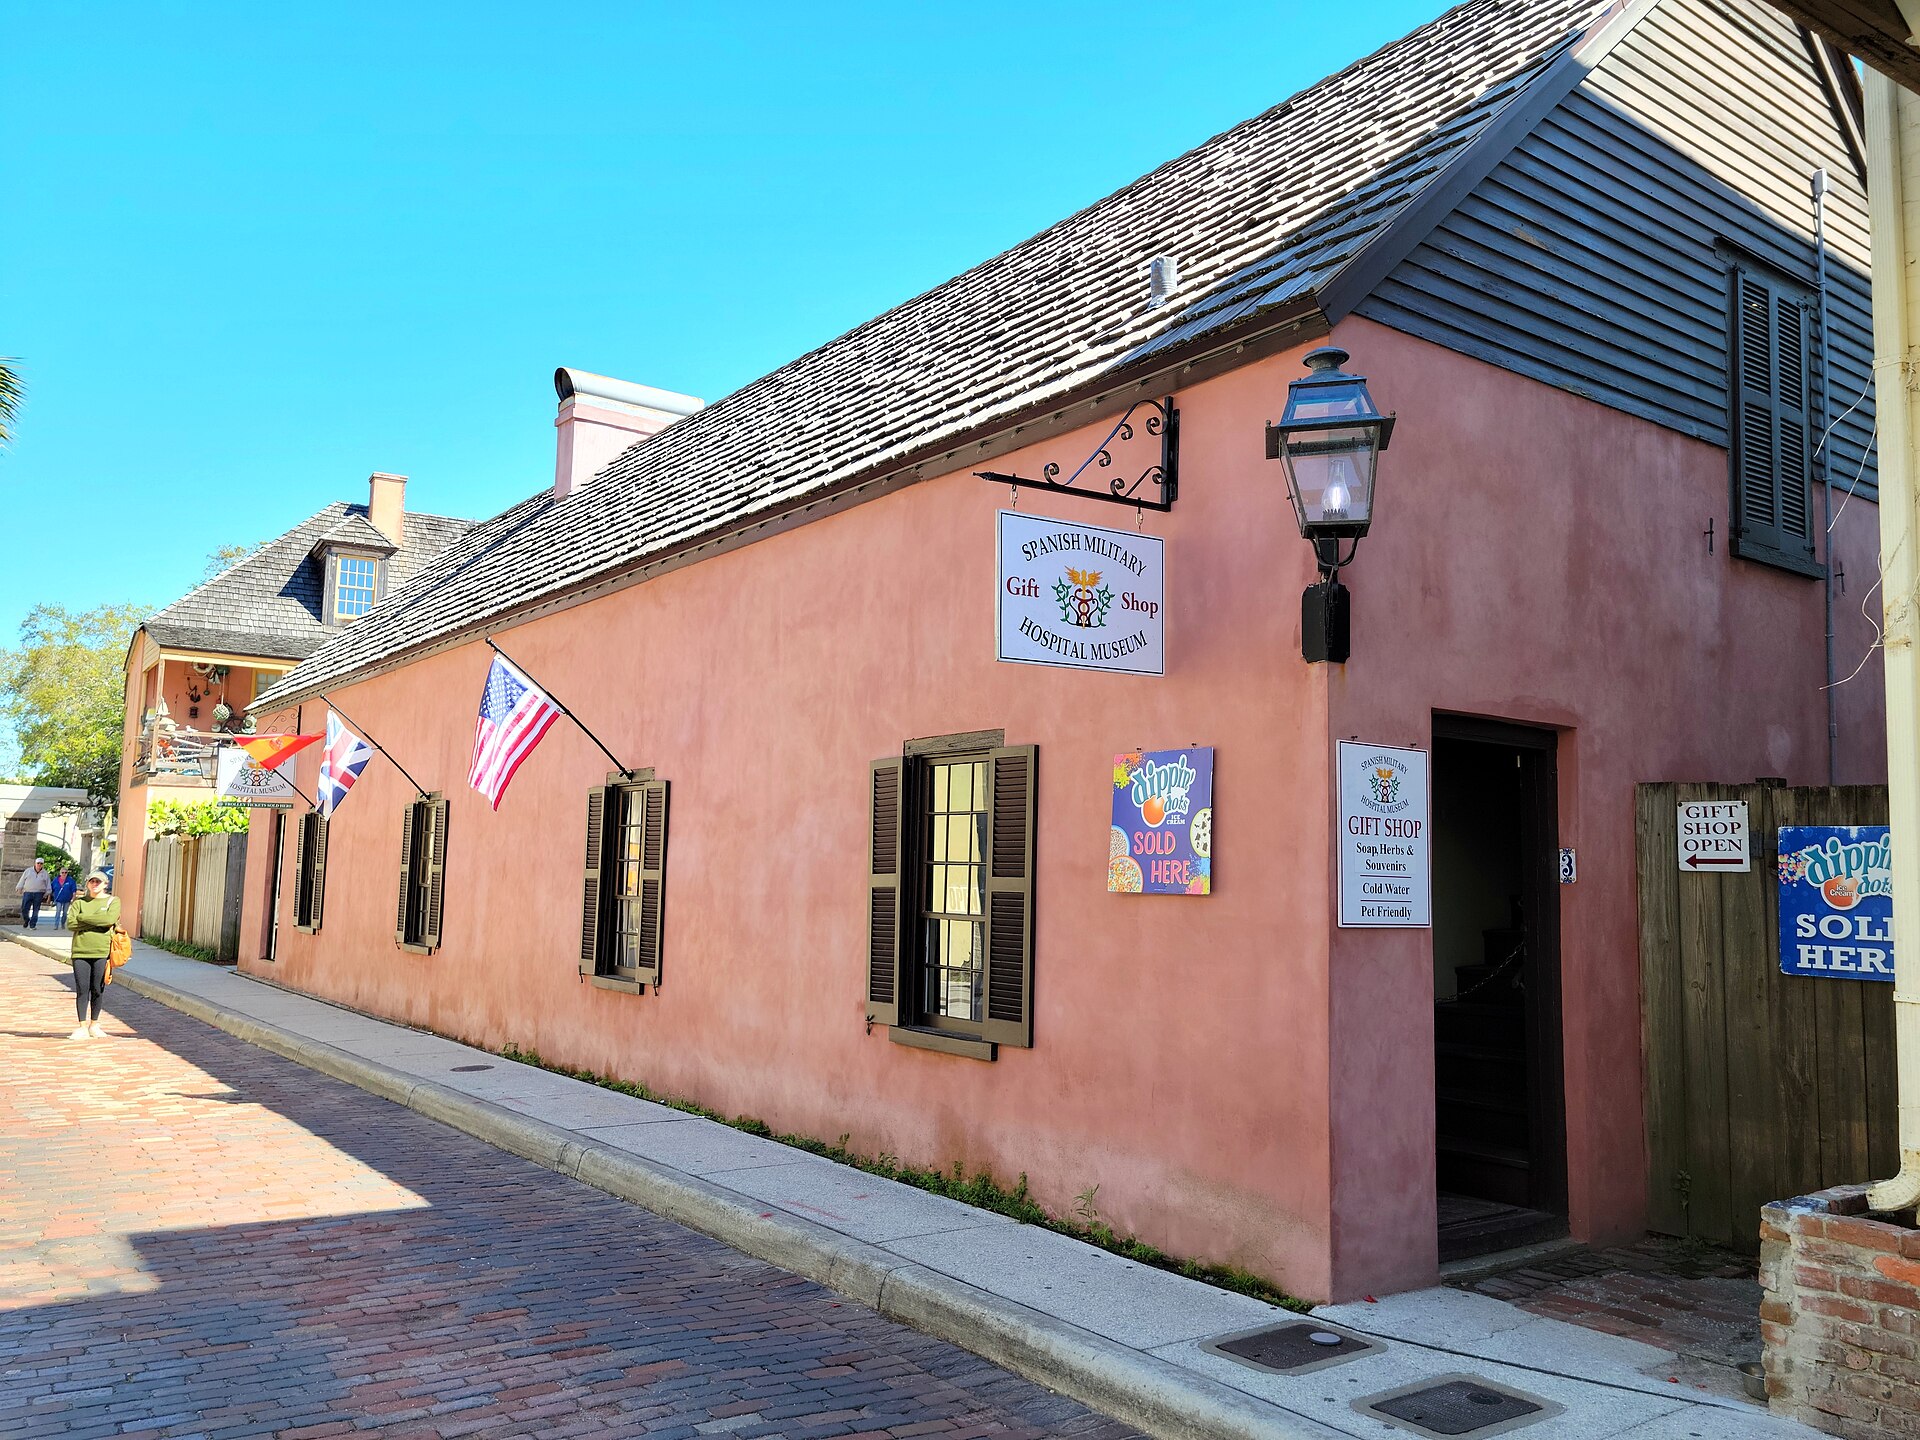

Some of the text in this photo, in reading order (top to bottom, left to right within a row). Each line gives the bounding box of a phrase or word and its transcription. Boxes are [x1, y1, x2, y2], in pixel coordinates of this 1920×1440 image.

[1021, 533, 1147, 577] SPANISH MILITARY
[1006, 576, 1040, 598] Gift
[1121, 592, 1159, 619] Shop
[1019, 616, 1148, 660] HOSPITAL MUSEUM
[1361, 756, 1408, 774] SPANISH MILITARY
[258, 783, 286, 794] MUSEUM
[1164, 794, 1188, 813] dots
[1361, 795, 1409, 813] HOSPITAL MUSEUM
[1685, 805, 1738, 818] GIFT
[1348, 815, 1422, 839] GIFT SHOP
[1683, 822, 1742, 835] SHOP
[1133, 831, 1176, 855] SOLD
[1356, 842, 1414, 857] Soap, Herbs &
[1683, 838, 1742, 852] OPEN
[1151, 860, 1191, 885] HERE
[1365, 859, 1406, 871] Souvenirs
[1562, 854, 1573, 877] 3
[1362, 882, 1410, 895] Cold Water
[1829, 889, 1854, 898] Cream
[1361, 906, 1412, 920] Pet Friendly
[1796, 944, 1895, 974] HER
